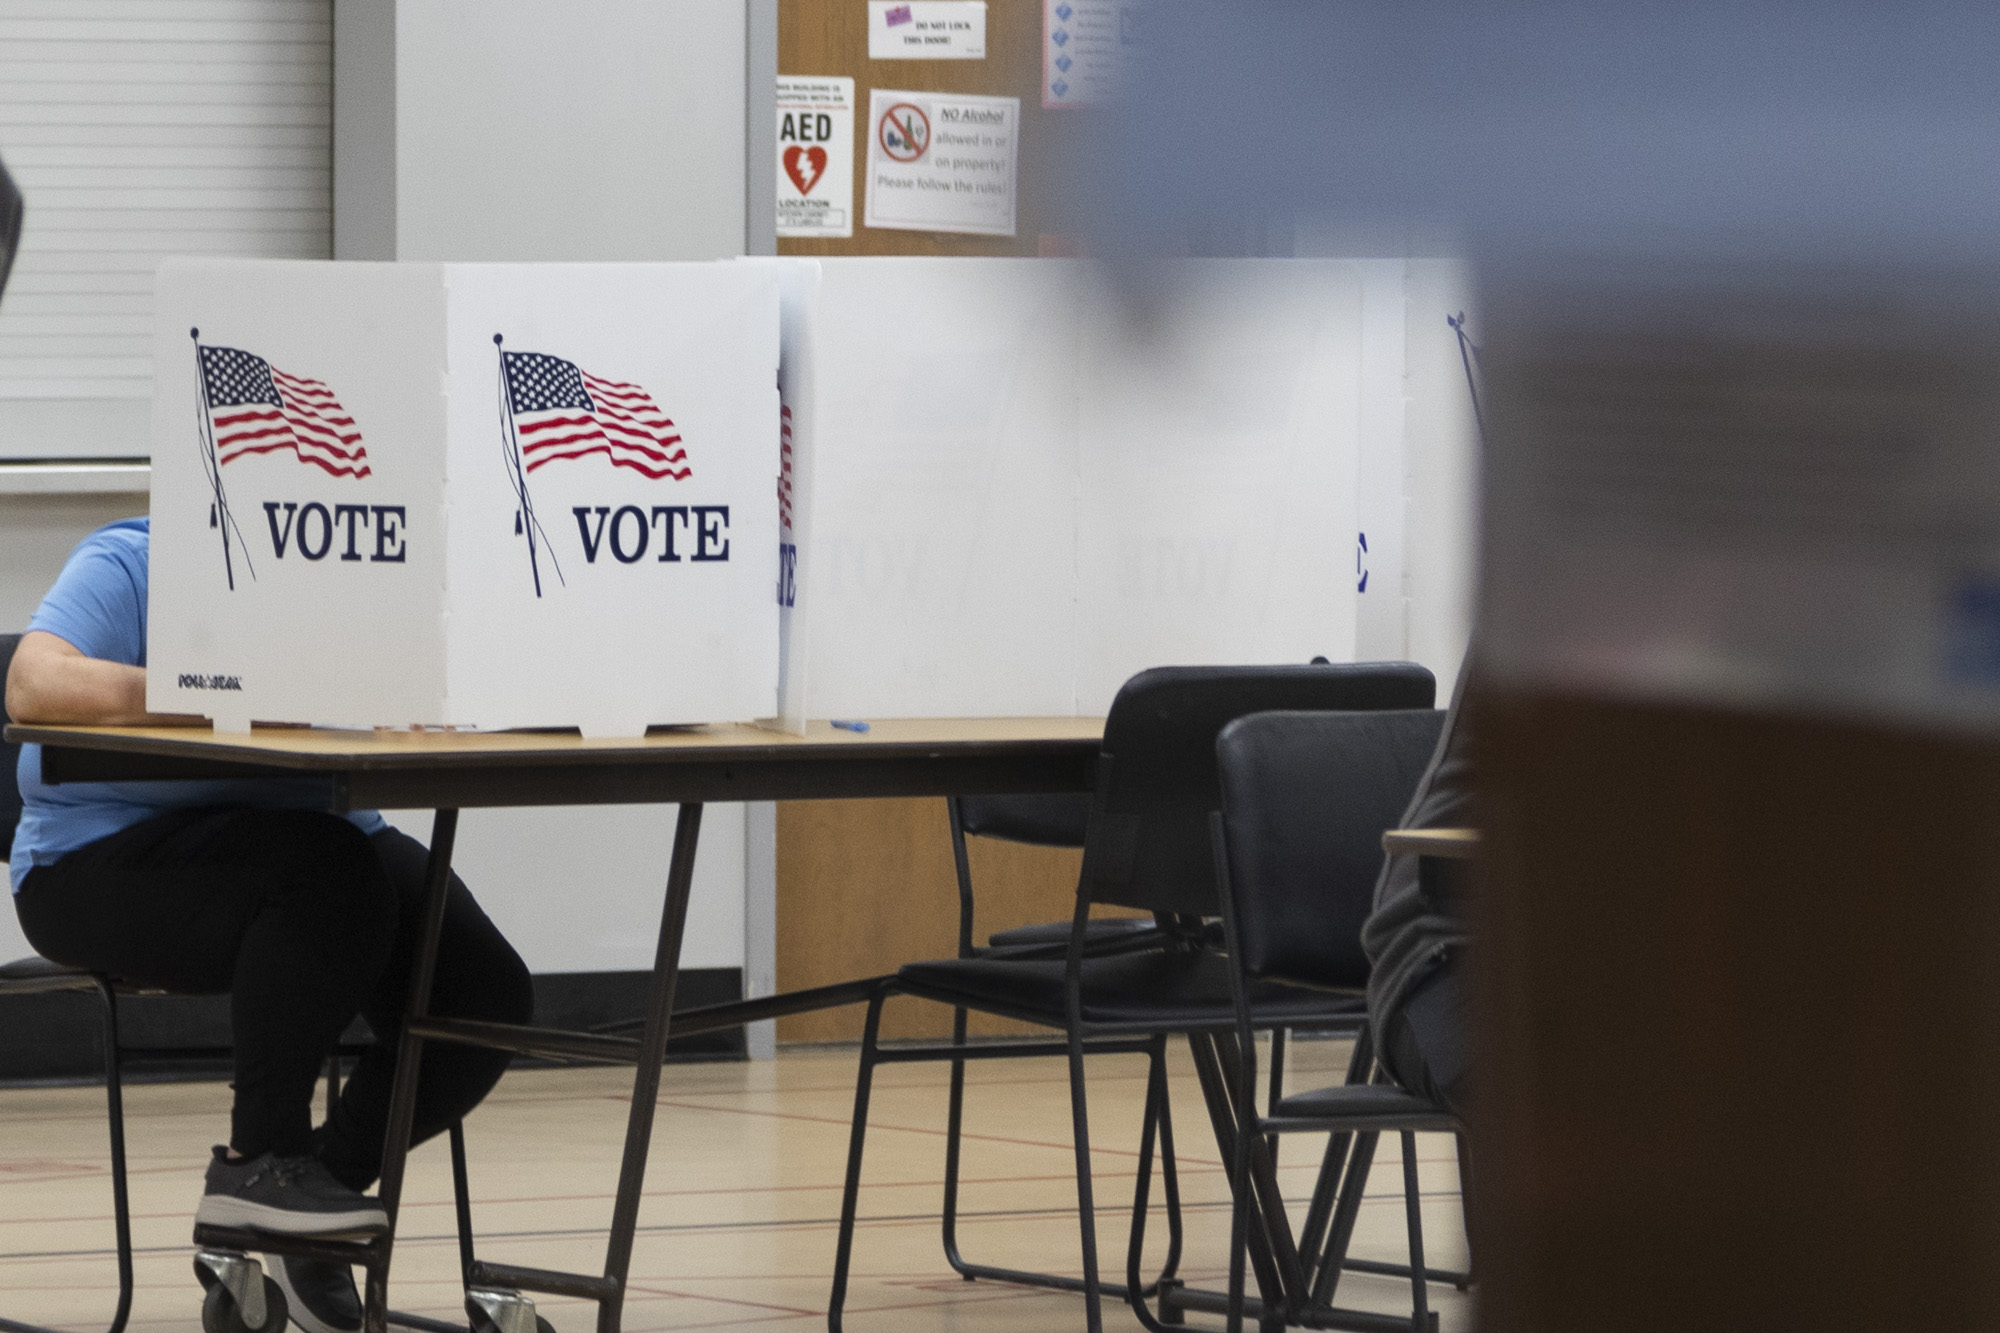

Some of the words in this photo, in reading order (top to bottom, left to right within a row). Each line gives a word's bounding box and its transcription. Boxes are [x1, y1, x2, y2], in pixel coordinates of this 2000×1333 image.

[916, 21, 928, 30] DO
[931, 21, 946, 30] NOT
[949, 21, 971, 31] LOCK
[904, 36, 922, 44] THIS
[941, 107, 959, 121] NO
[962, 108, 1004, 122] Alcohol
[780, 112, 832, 142] AED
[936, 131, 979, 145] allowed
[982, 132, 993, 146] in
[996, 137, 1007, 147] or
[936, 157, 949, 168] on
[878, 175, 913, 188] Please
[917, 177, 952, 191] follow
[955, 179, 973, 192] the
[778, 199, 829, 208] LOCATION
[263, 502, 406, 563] VOTE
[572, 505, 730, 564] VOTE
[777, 543, 797, 607] TE
